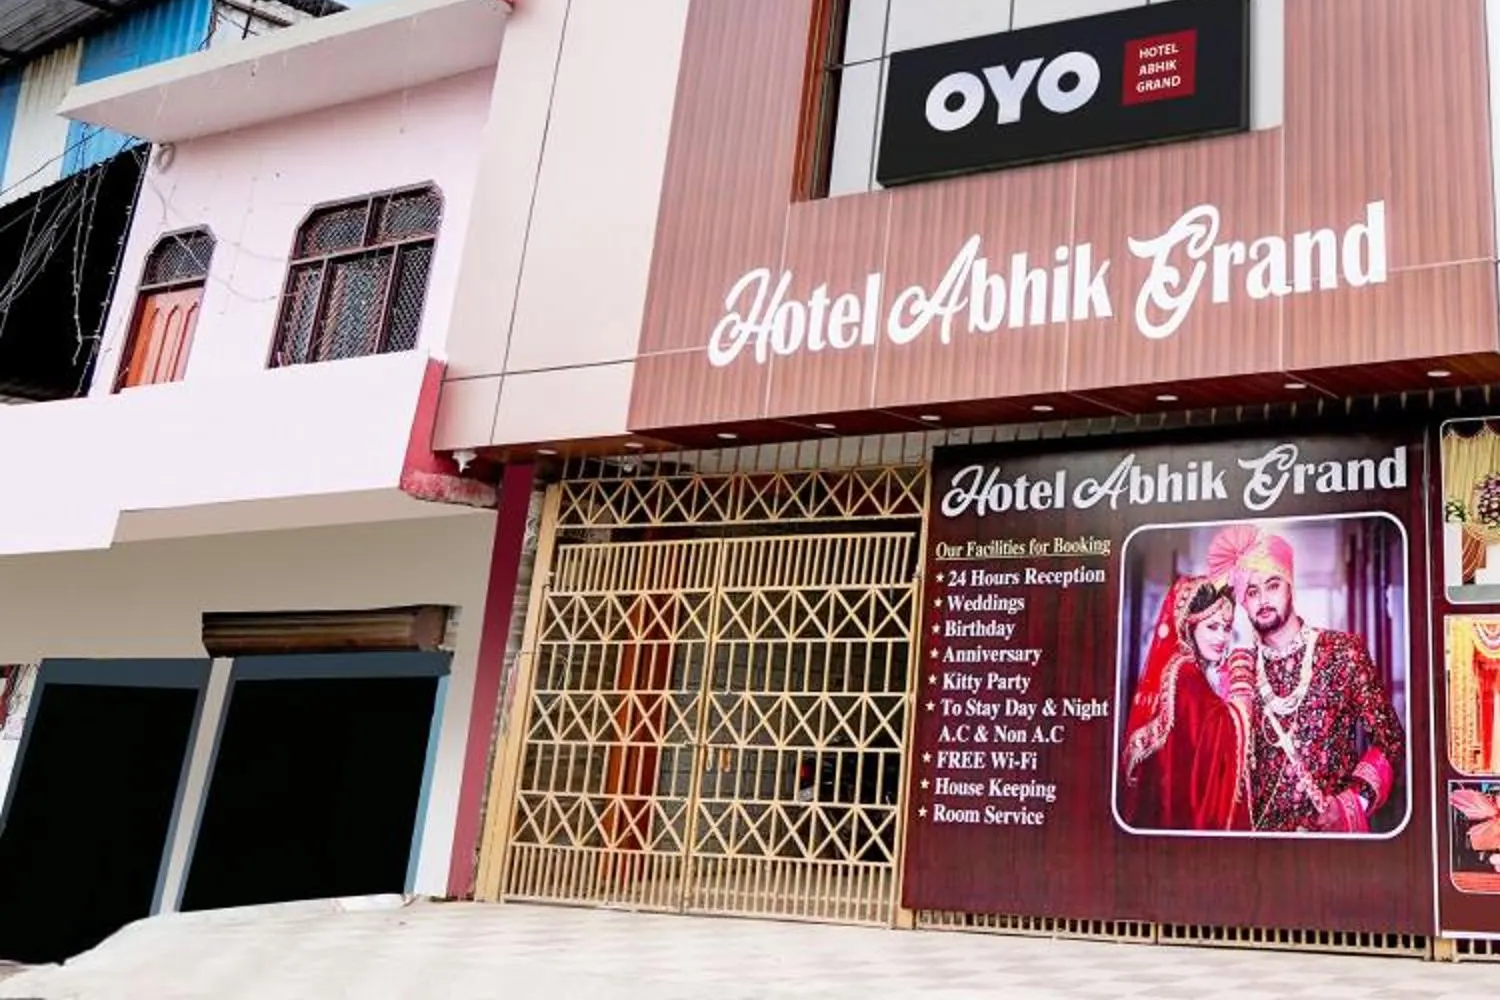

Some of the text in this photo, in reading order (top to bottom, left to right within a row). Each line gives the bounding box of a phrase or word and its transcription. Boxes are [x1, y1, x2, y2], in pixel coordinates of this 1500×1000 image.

[1139, 43, 1180, 59] HOTEL
[1138, 59, 1177, 76] ABHIK
[925, 50, 1101, 132] OYO
[1136, 75, 1181, 93] GRAND
[707, 200, 1386, 368] Hotel Abhik Grand
[941, 443, 1408, 518] Hotel Abhik Grand
[936, 536, 1111, 558] Our Facilities for Booking
[947, 566, 1105, 588] 24 Hours Reception
[947, 594, 1025, 614] Weddings
[944, 620, 1016, 640] Birthday
[942, 645, 1043, 665] Anniversary
[942, 673, 1031, 694] Kitty Party
[940, 698, 1109, 720] To Stay Day & Night
[938, 725, 1065, 743] A.C & Non A.C
[936, 751, 1038, 770] FREE Wi-Fi
[934, 777, 1056, 802] House Keeping
[933, 804, 1045, 825] Room Service
